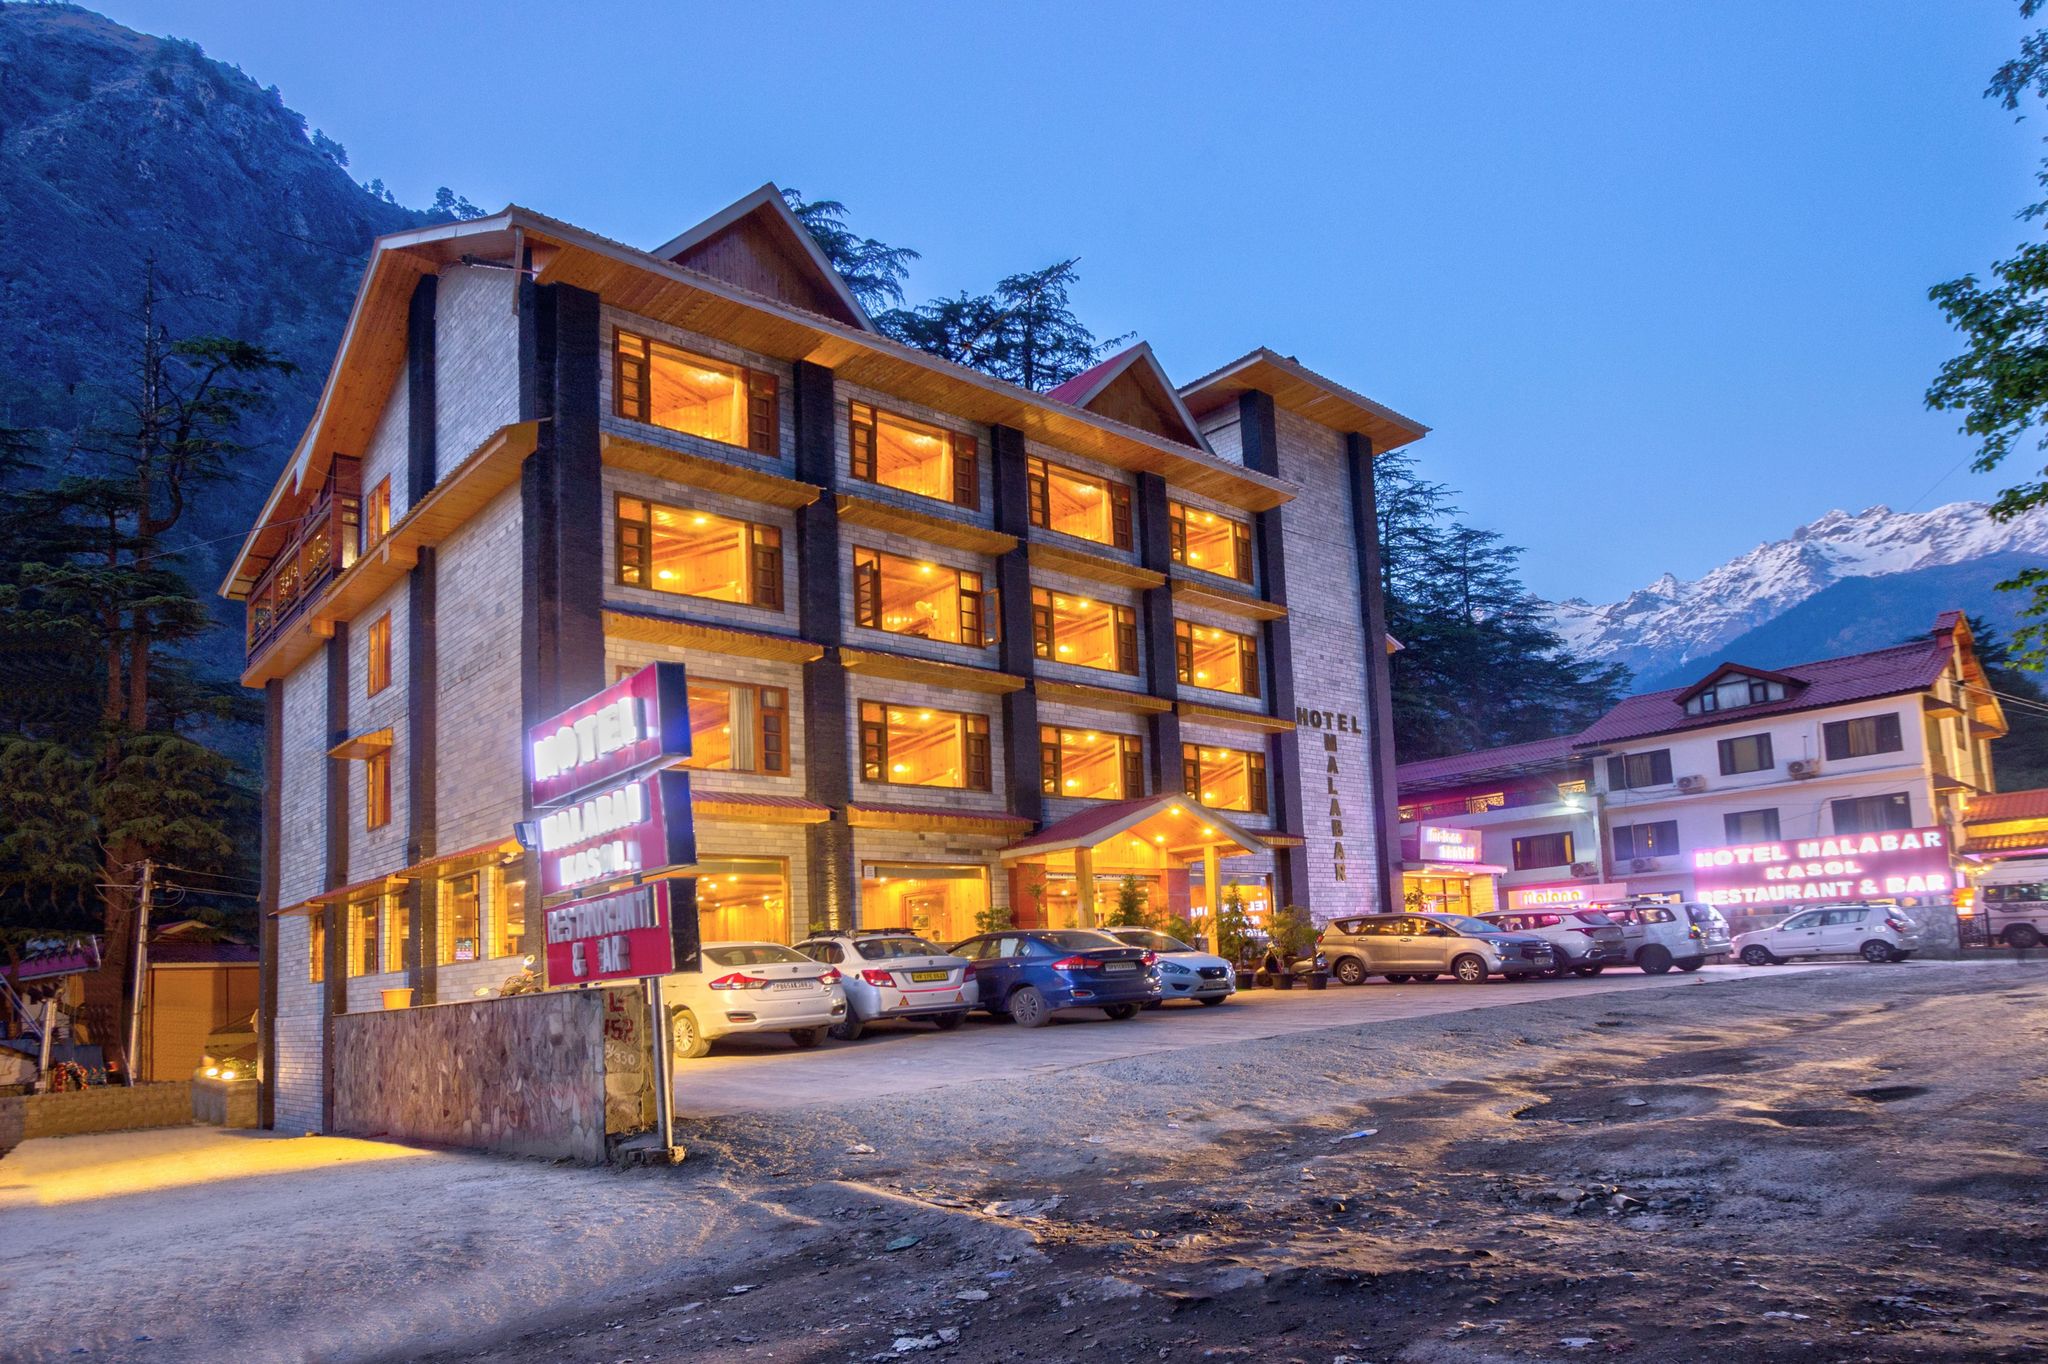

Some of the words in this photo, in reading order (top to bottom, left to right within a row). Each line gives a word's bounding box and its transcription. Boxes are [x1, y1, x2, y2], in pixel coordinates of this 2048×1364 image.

[1296, 706, 1362, 734] HOTEL
[1323, 733, 1347, 881] MALABAR
[1695, 845, 1789, 867] HOTEL
[1797, 831, 1943, 858] MALABAR
[1765, 860, 1862, 880] KASOL
[1697, 880, 1854, 905] RESTAURANT
[1859, 878, 1879, 895] &
[1886, 874, 1947, 893] BAR
[547, 886, 655, 944] RESTAURANT
